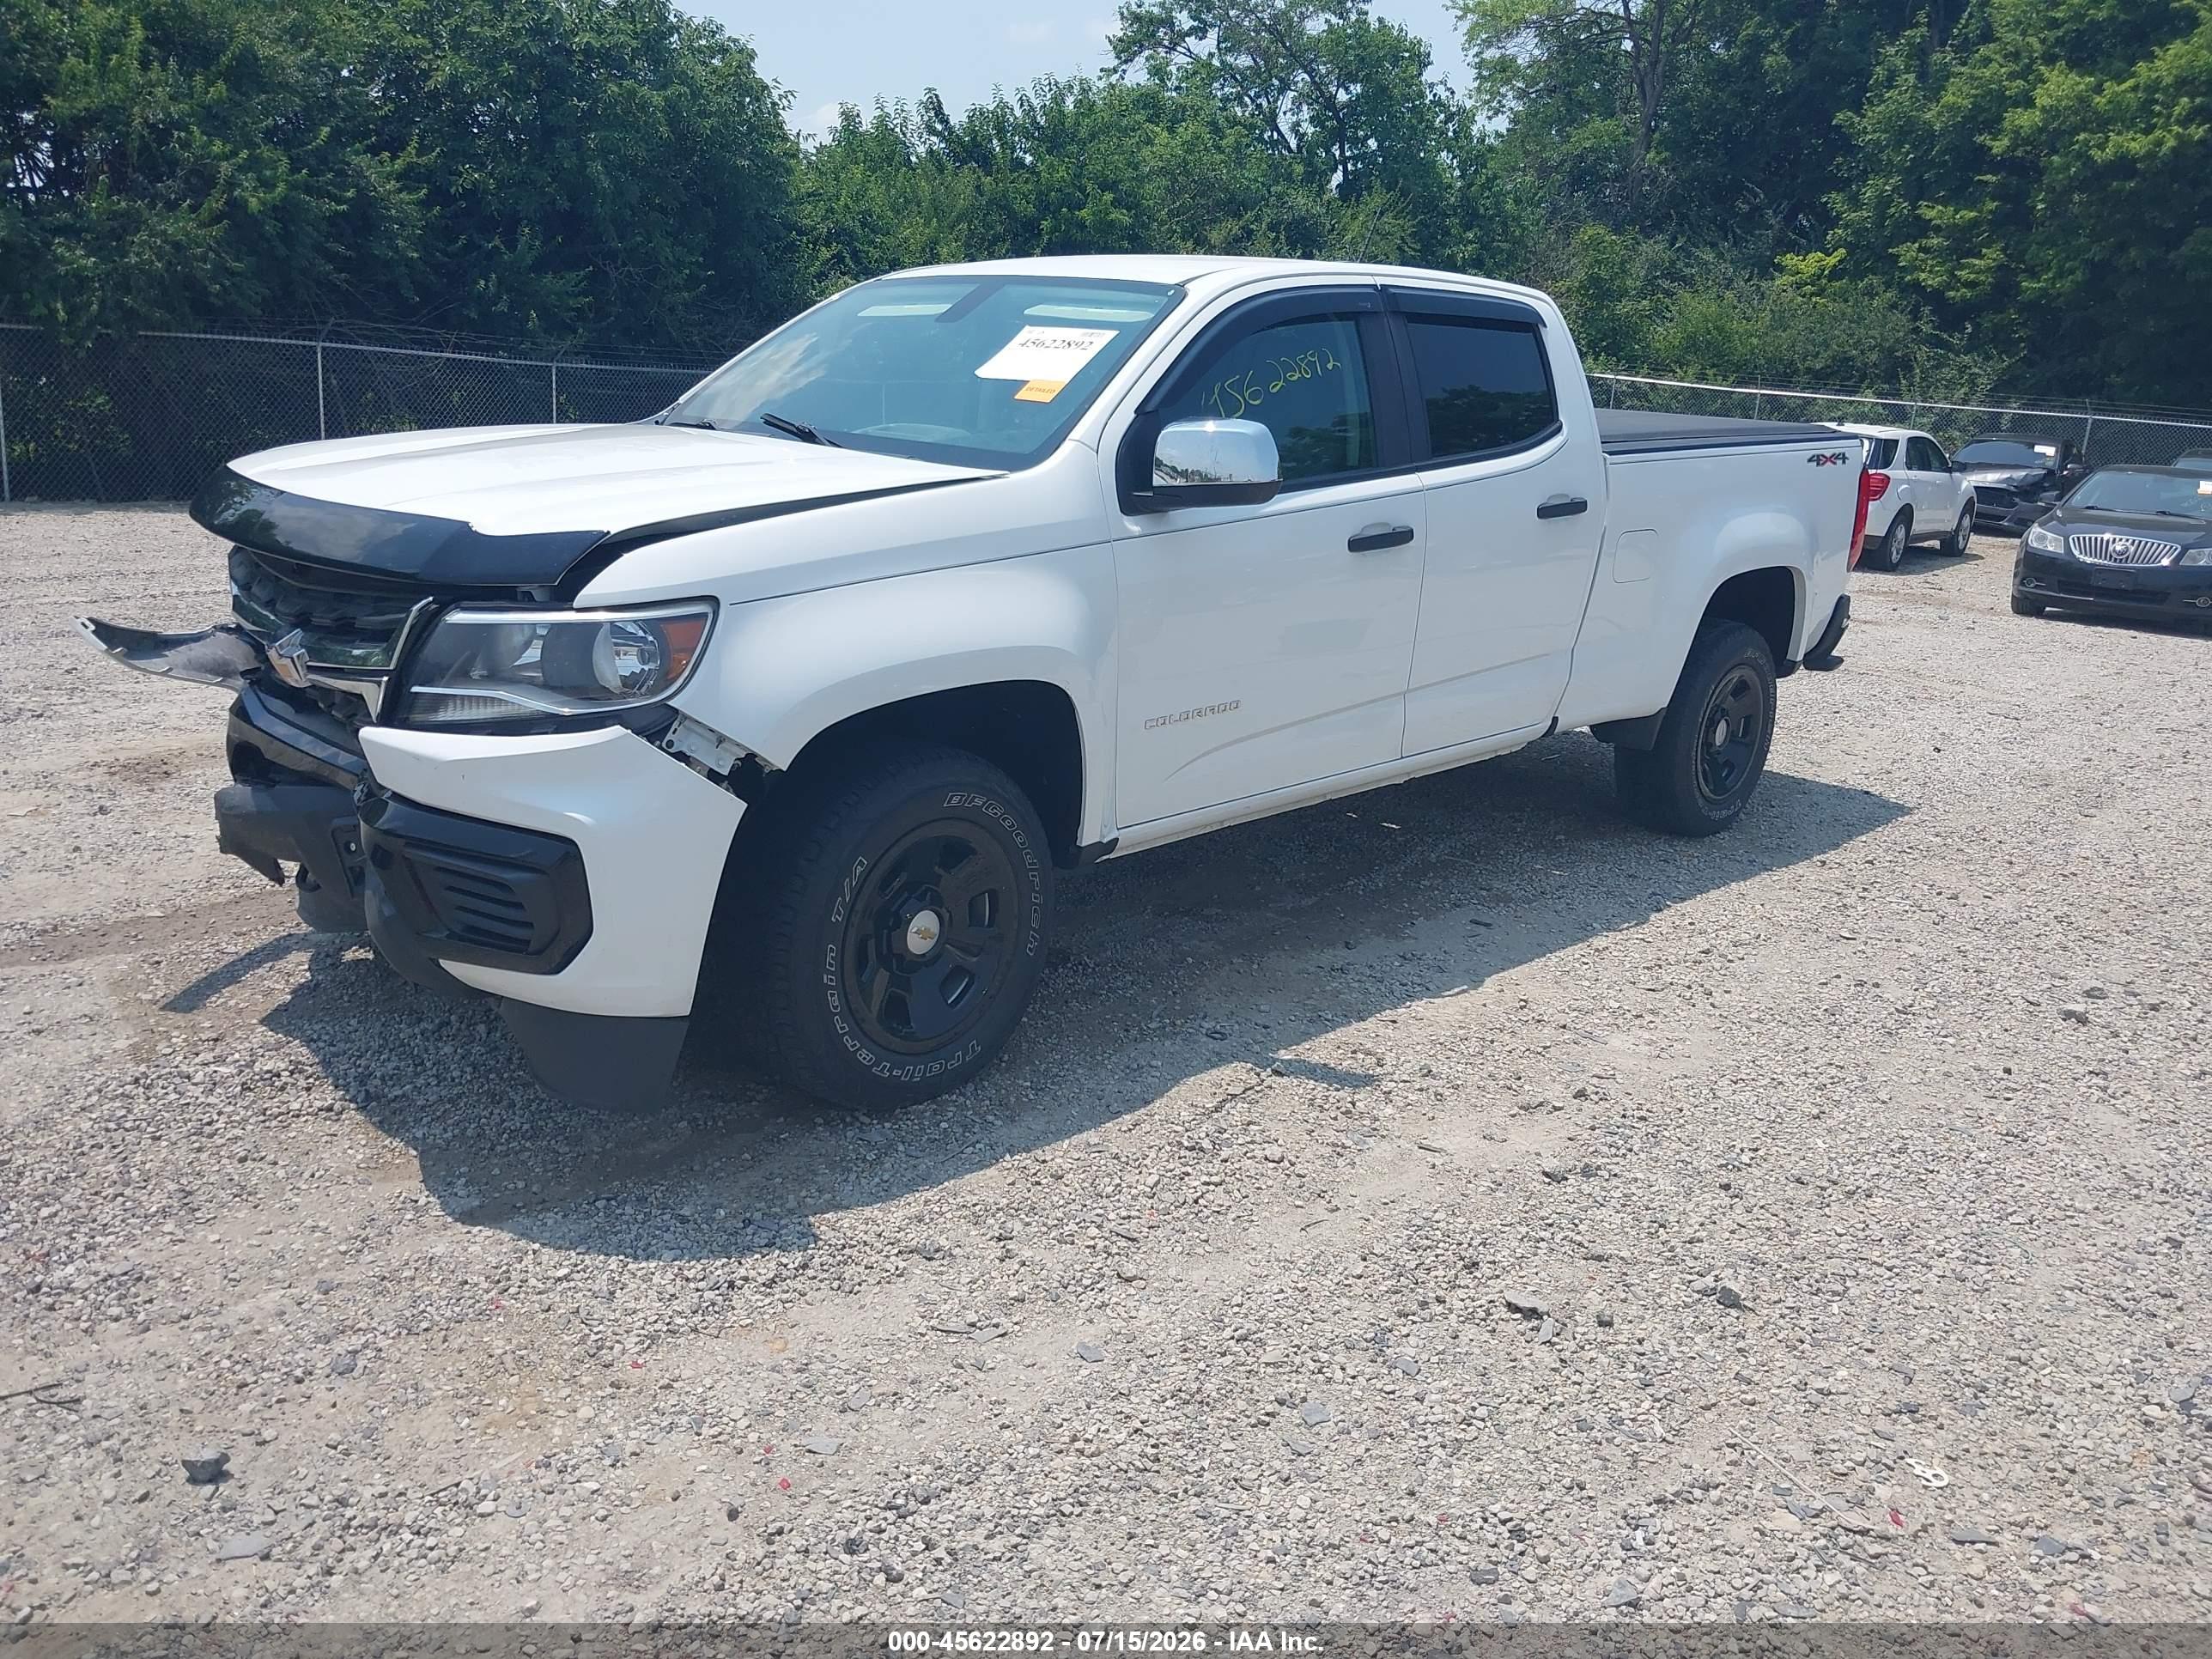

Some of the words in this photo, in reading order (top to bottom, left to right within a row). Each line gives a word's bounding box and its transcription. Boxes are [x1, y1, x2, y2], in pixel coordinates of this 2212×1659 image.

[1018, 338, 1095, 350] 45622892
[1144, 700, 1241, 730] COLORADO
[831, 856, 868, 923] T/A
[944, 792, 1044, 956] BFGoodrich
[823, 944, 982, 1082] Trail-Terrain
